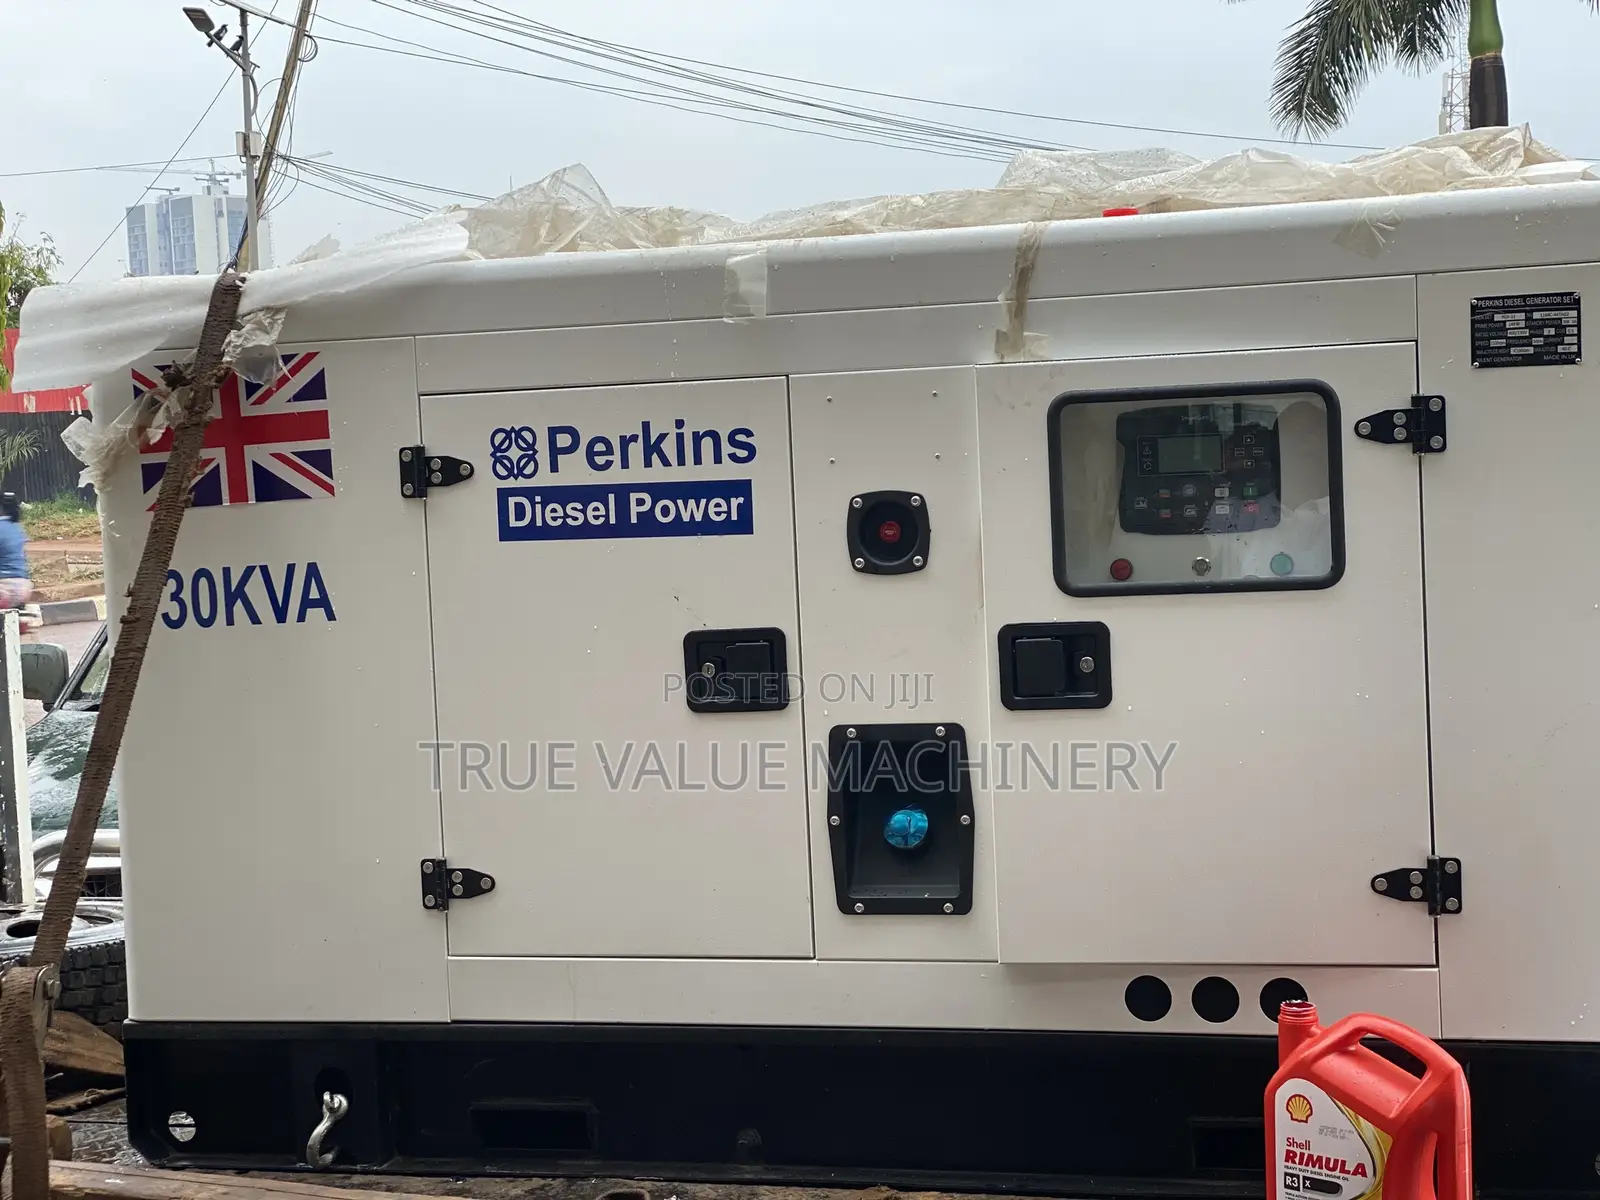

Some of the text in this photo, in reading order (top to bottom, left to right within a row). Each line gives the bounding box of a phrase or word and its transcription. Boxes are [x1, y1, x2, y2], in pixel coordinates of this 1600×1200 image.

[1477, 295, 1574, 308] PERKINS DIESEL GENERATOR SET
[547, 419, 757, 473] Perkins
[508, 492, 744, 528] Diesel Power
[161, 562, 337, 630] 30KVA
[1286, 1136, 1311, 1151] Shell
[1284, 1149, 1368, 1178] RIMULA
[1285, 1175, 1311, 1188] R3 X
